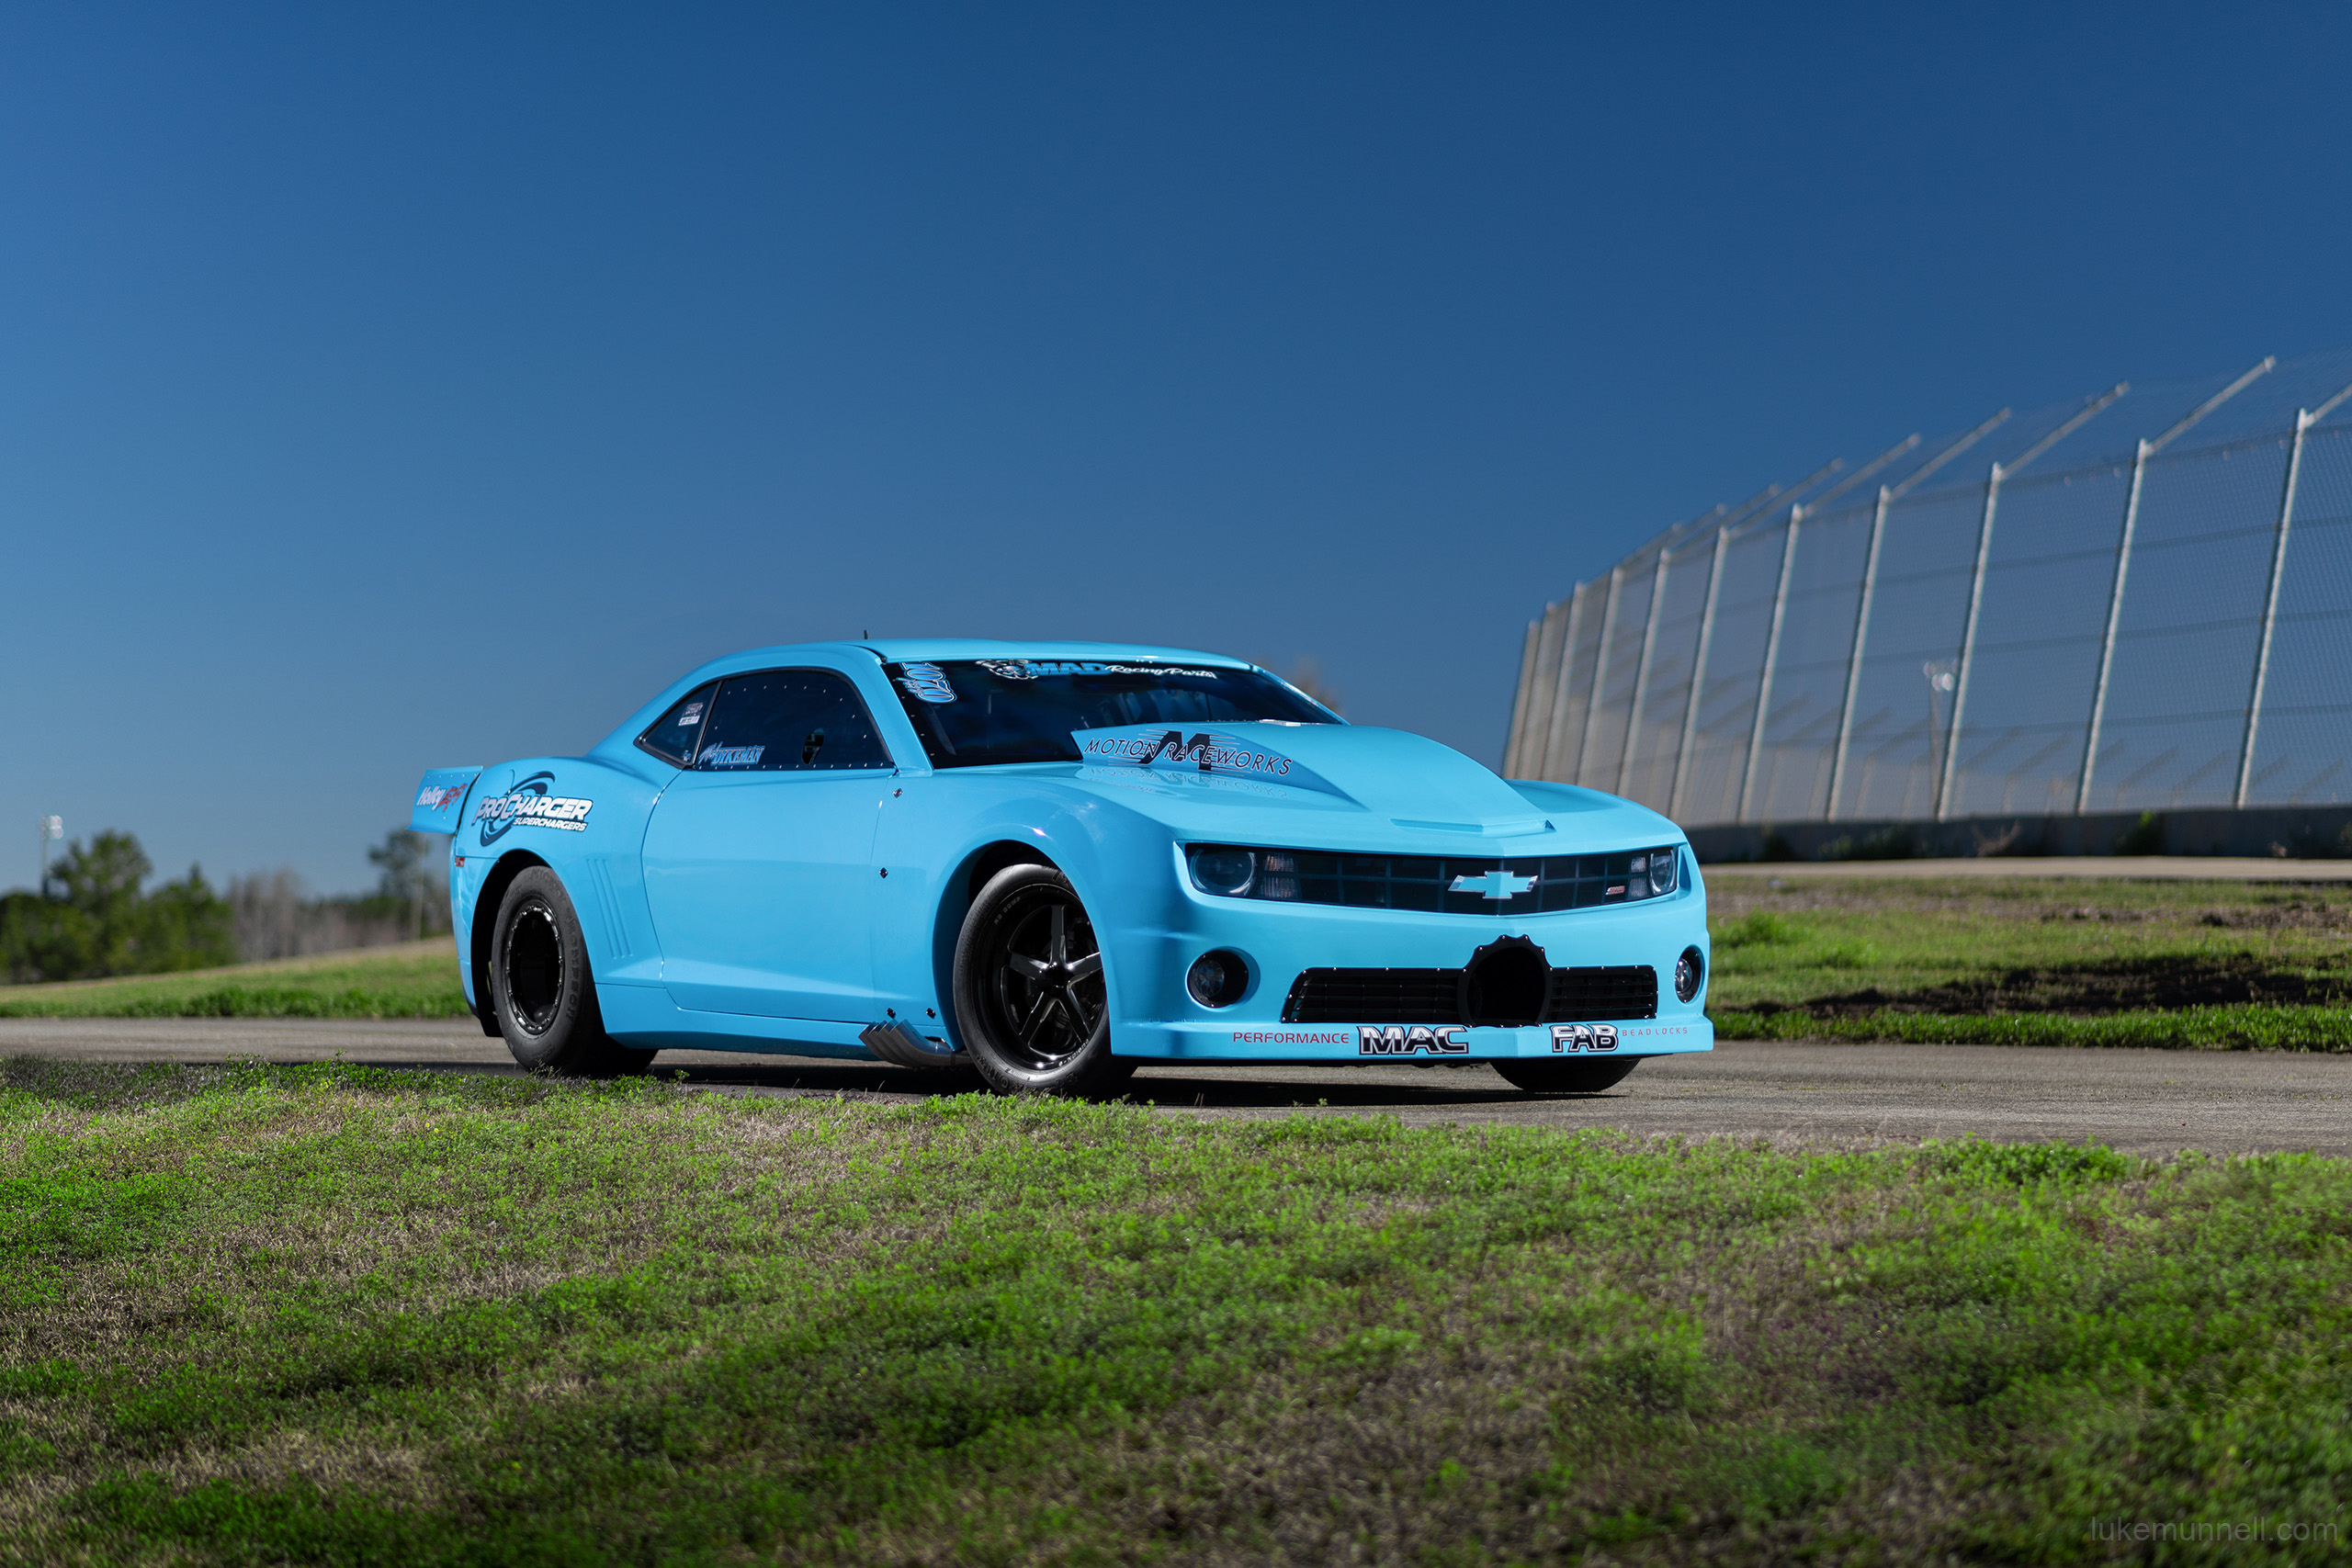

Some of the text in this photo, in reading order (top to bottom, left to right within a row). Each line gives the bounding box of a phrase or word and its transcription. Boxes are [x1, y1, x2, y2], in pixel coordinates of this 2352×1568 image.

[1030, 662, 1110, 675] MAD
[1105, 665, 1167, 676] Racing
[711, 746, 765, 766] DYKEMAN
[1083, 738, 1293, 776] MOTION RACEWORKS
[416, 785, 446, 811] Holley
[513, 816, 587, 832] SUPERCHARGERS
[1233, 1032, 1350, 1043] PERFORMANCE
[1357, 1026, 1469, 1055] MAC
[1550, 1023, 1619, 1053] FAB
